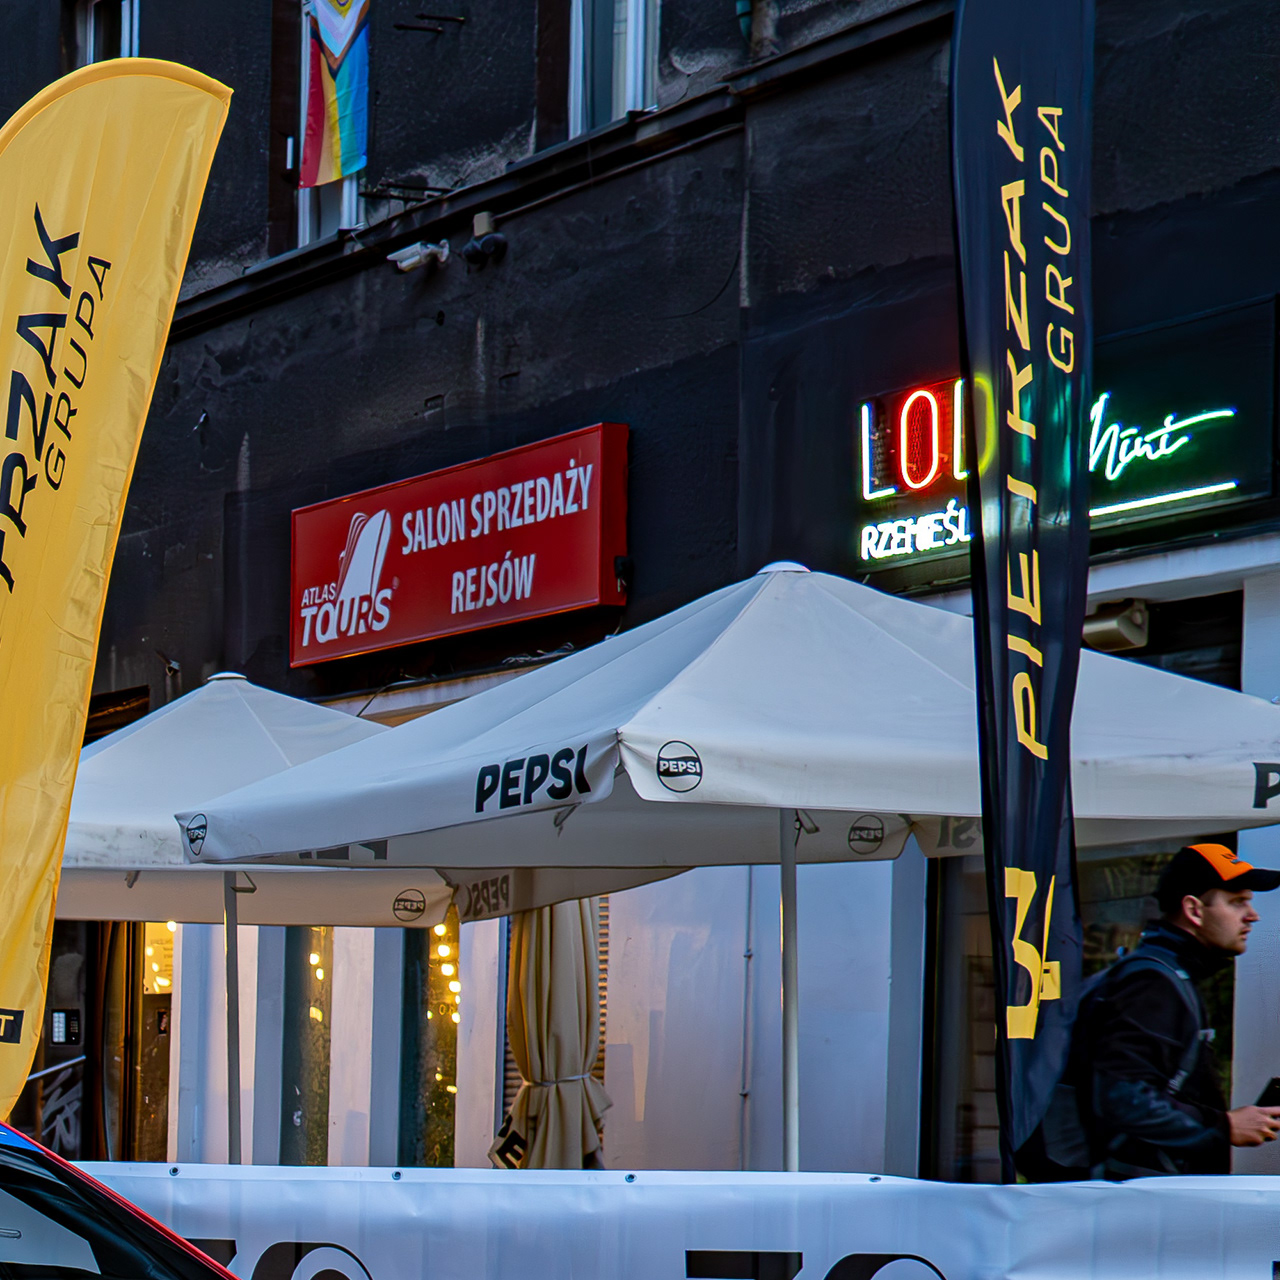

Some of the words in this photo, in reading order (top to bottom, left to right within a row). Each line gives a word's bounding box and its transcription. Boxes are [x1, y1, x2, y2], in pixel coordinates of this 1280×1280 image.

[1037, 106, 1075, 374] GRUPA
[44, 255, 112, 491] GRUPA
[401, 494, 466, 556] SALON
[470, 458, 594, 538] SPRZEDAŻY
[300, 582, 337, 608] ATLAS
[451, 551, 537, 615] REJSÓW
[300, 588, 392, 648] TOURS
[474, 743, 592, 814] PEPSI
[658, 759, 702, 775] PEPSI
